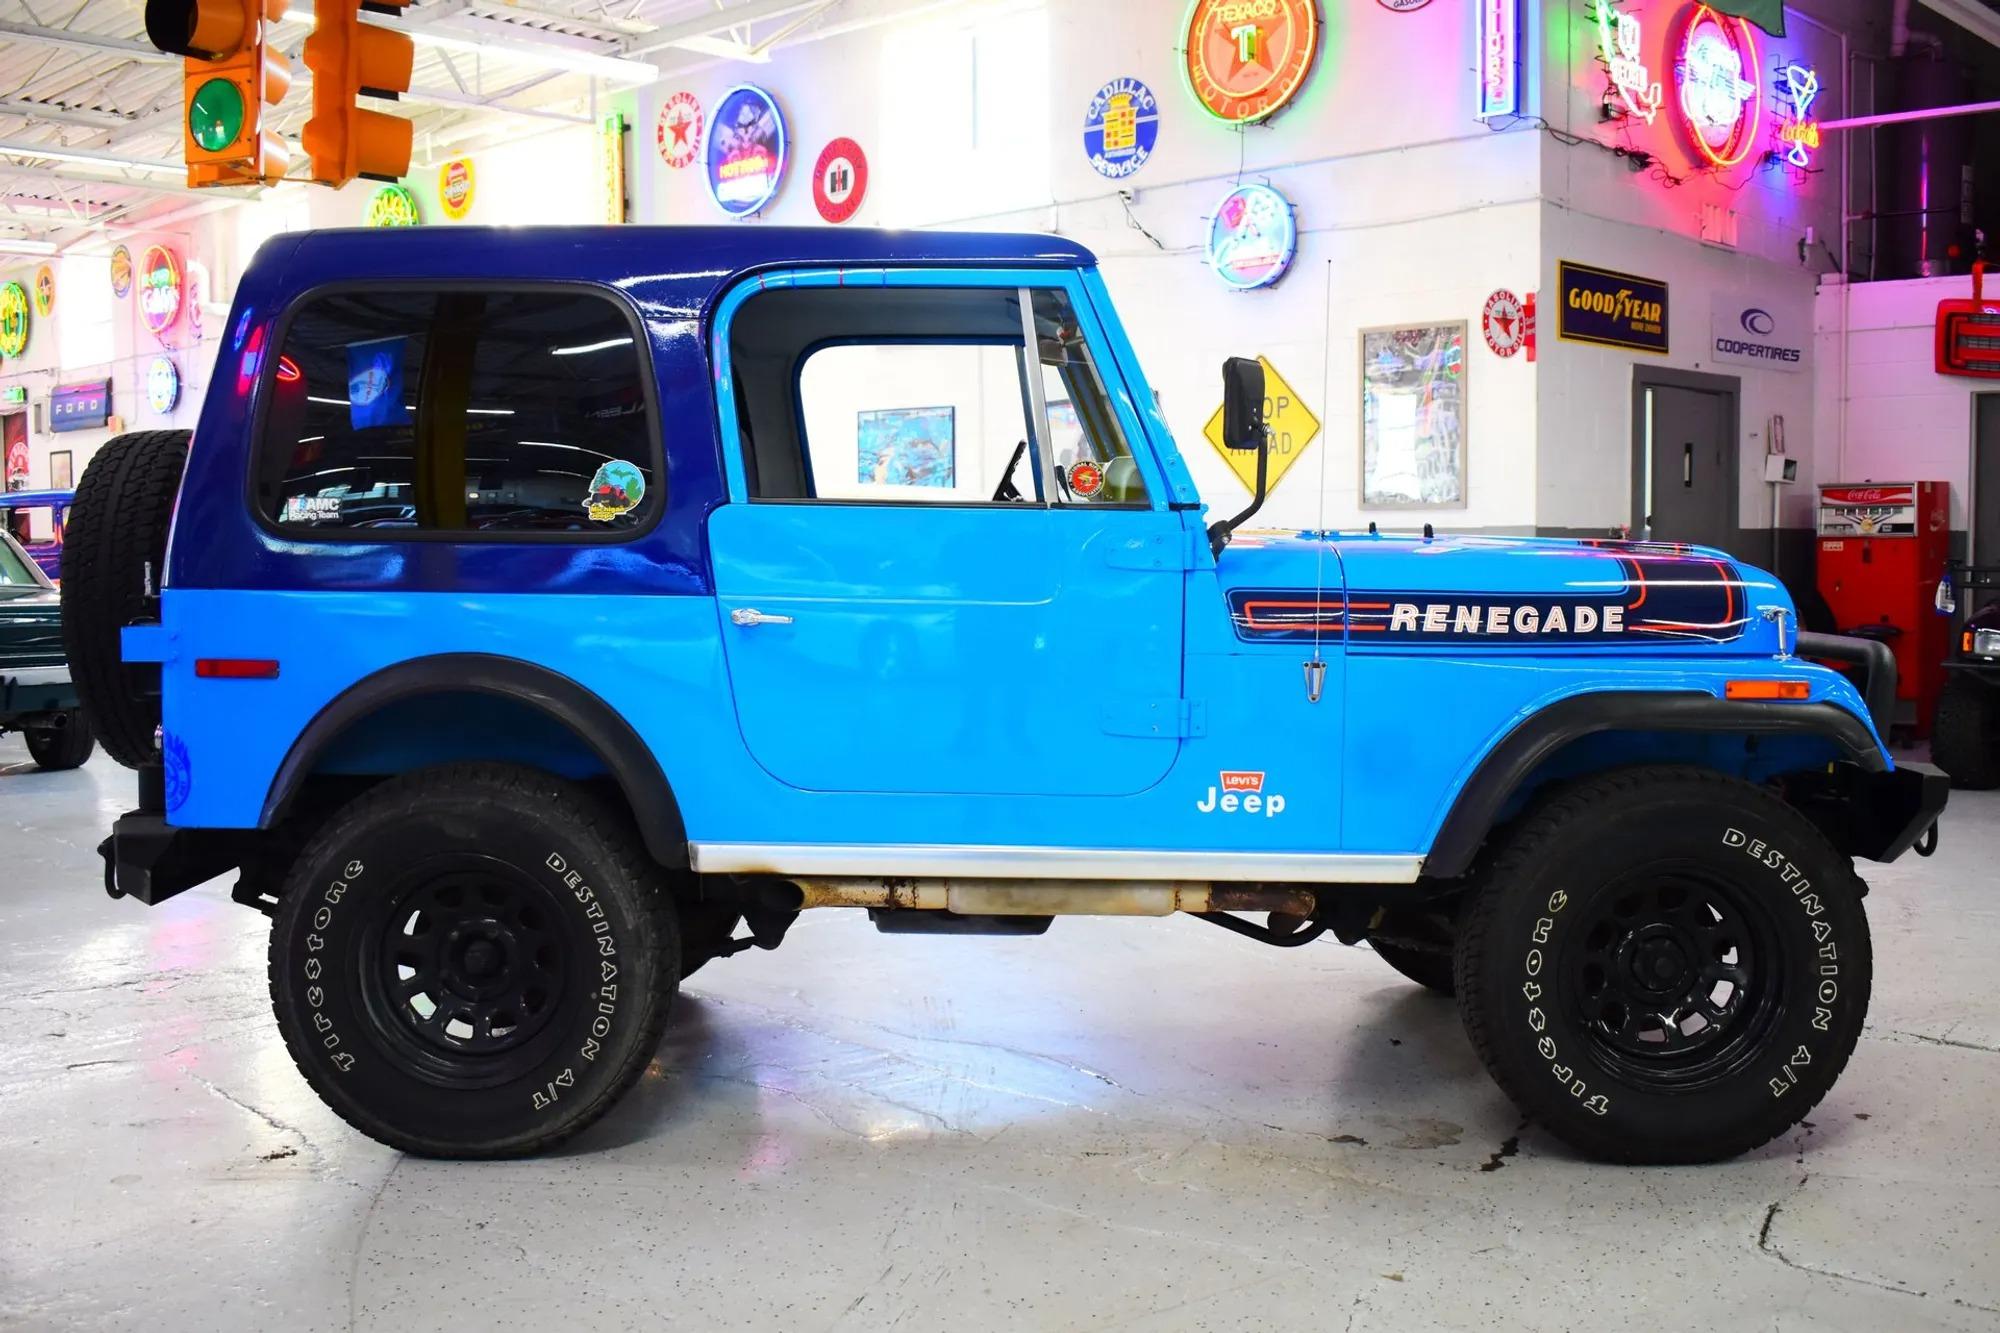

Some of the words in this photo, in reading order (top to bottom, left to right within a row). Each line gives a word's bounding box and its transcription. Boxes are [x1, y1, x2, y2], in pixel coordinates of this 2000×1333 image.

[1215, 0, 1277, 23] TEXACO
[1192, 63, 1269, 118] MOTOR
[1280, 49, 1307, 94] OIL
[1088, 79, 1154, 120] CADILLAC
[1484, 291, 1524, 318] GASOLINE
[1569, 288, 1661, 322] GOODYEAR
[1484, 329, 1513, 356] MOTOR
[1513, 333, 1523, 351] OIL
[56, 400, 98, 416] FORD
[1262, 397, 1290, 419] OP
[307, 498, 340, 510] AMC
[1848, 489, 1881, 501] Coca-Cola
[292, 510, 317, 520] Racing
[318, 510, 339, 519] Team
[1390, 603, 1625, 634] RENEGADE
[1196, 786, 1286, 818] Jeep
[1722, 827, 1838, 1031] DESTINATION
[545, 852, 617, 1061] DESTINATION
[1768, 1045, 1812, 1098] A/T
[532, 1068, 575, 1111] A/T
